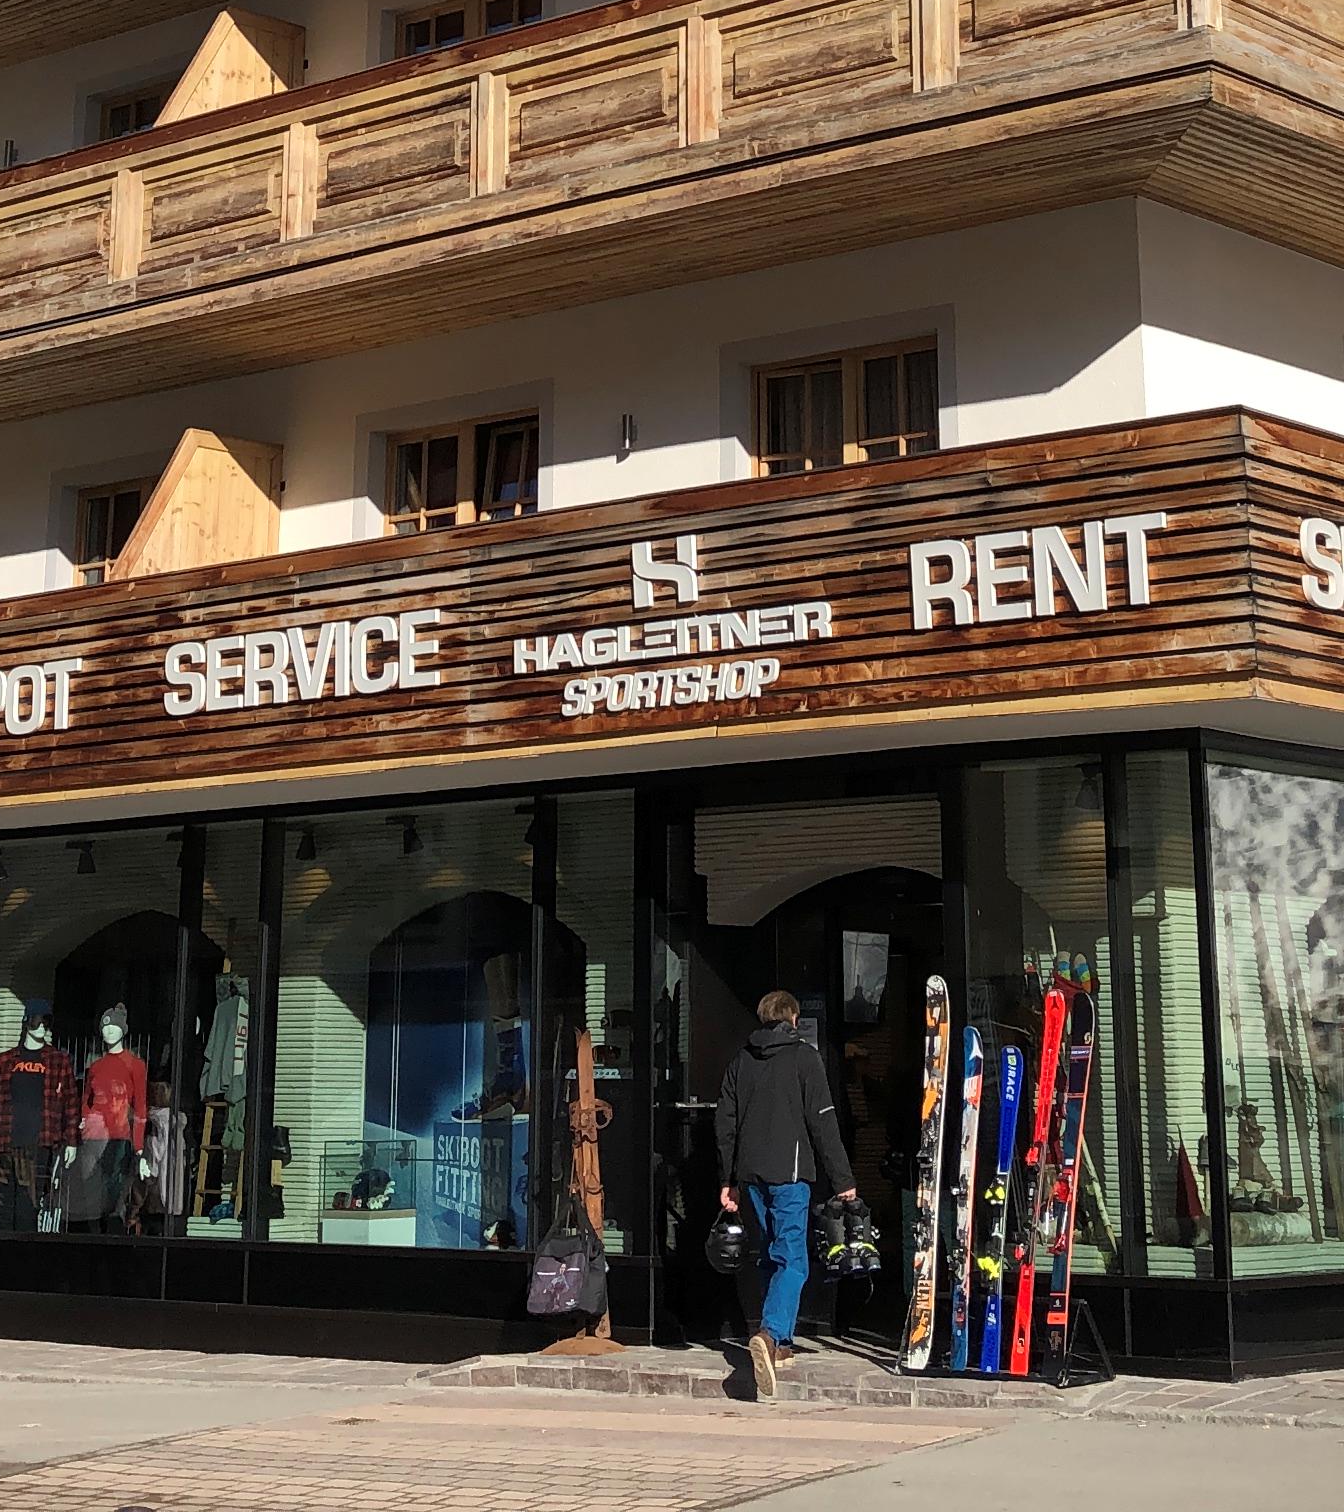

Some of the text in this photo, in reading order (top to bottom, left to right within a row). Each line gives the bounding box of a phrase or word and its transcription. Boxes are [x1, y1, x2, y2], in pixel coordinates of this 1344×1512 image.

[910, 512, 1167, 630] RENT
[163, 608, 440, 716] SERVICE
[513, 601, 832, 674] HAGLEITNER
[561, 658, 780, 717] SPORTSHOP
